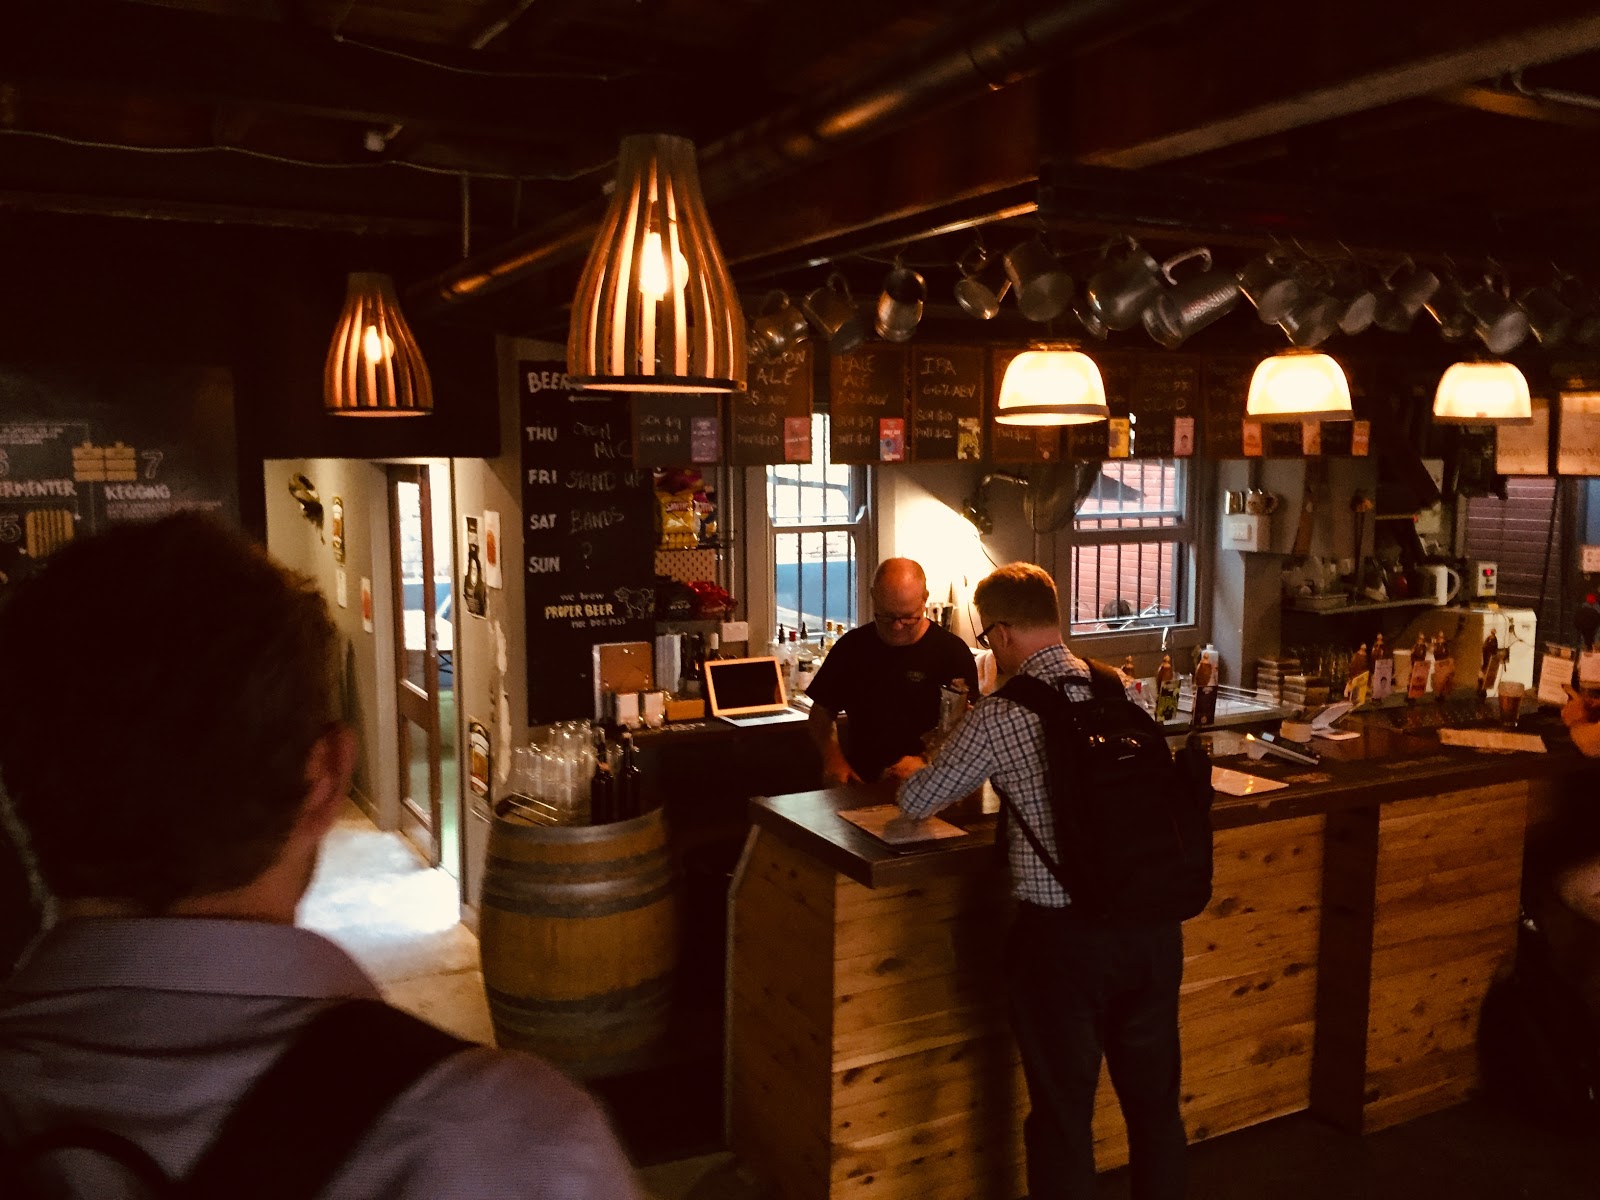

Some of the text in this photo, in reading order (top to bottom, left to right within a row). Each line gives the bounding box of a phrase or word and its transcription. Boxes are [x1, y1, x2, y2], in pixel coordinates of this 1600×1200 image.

[920, 357, 957, 376] IPA
[757, 367, 799, 386] ALE
[526, 426, 558, 442] THU
[593, 440, 632, 459] MIC
[140, 452, 164, 480] 7
[528, 469, 558, 485] FRI
[529, 513, 558, 531] SAT
[529, 556, 561, 574] SUN
[544, 602, 615, 620] PROPER BEER
